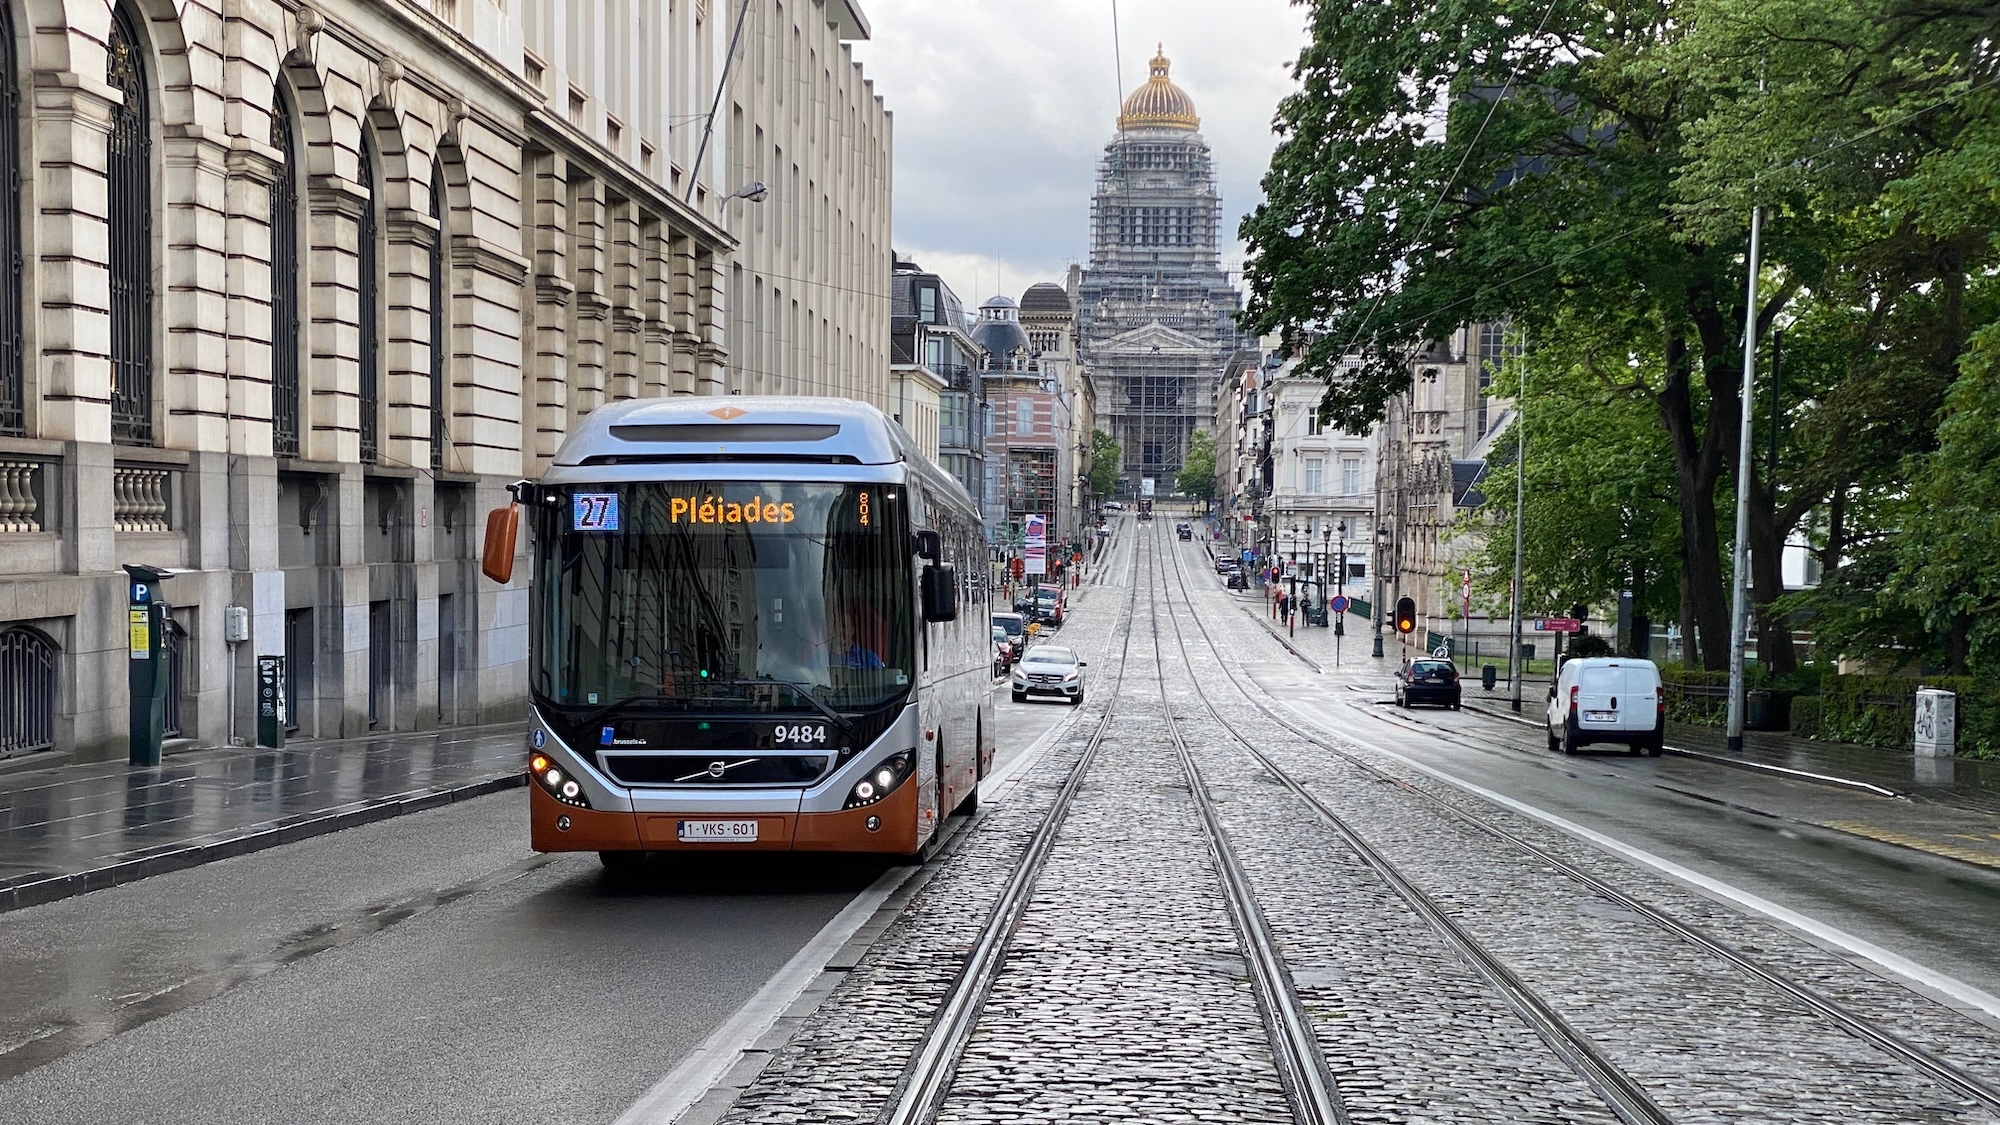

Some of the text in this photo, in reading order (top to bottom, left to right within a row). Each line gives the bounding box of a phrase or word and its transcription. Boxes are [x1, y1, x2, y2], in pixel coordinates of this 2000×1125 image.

[581, 497, 609, 526] 27
[670, 496, 795, 524] Pléiades
[859, 492, 869, 526] 804
[135, 583, 148, 601] P
[774, 725, 826, 743] 9484
